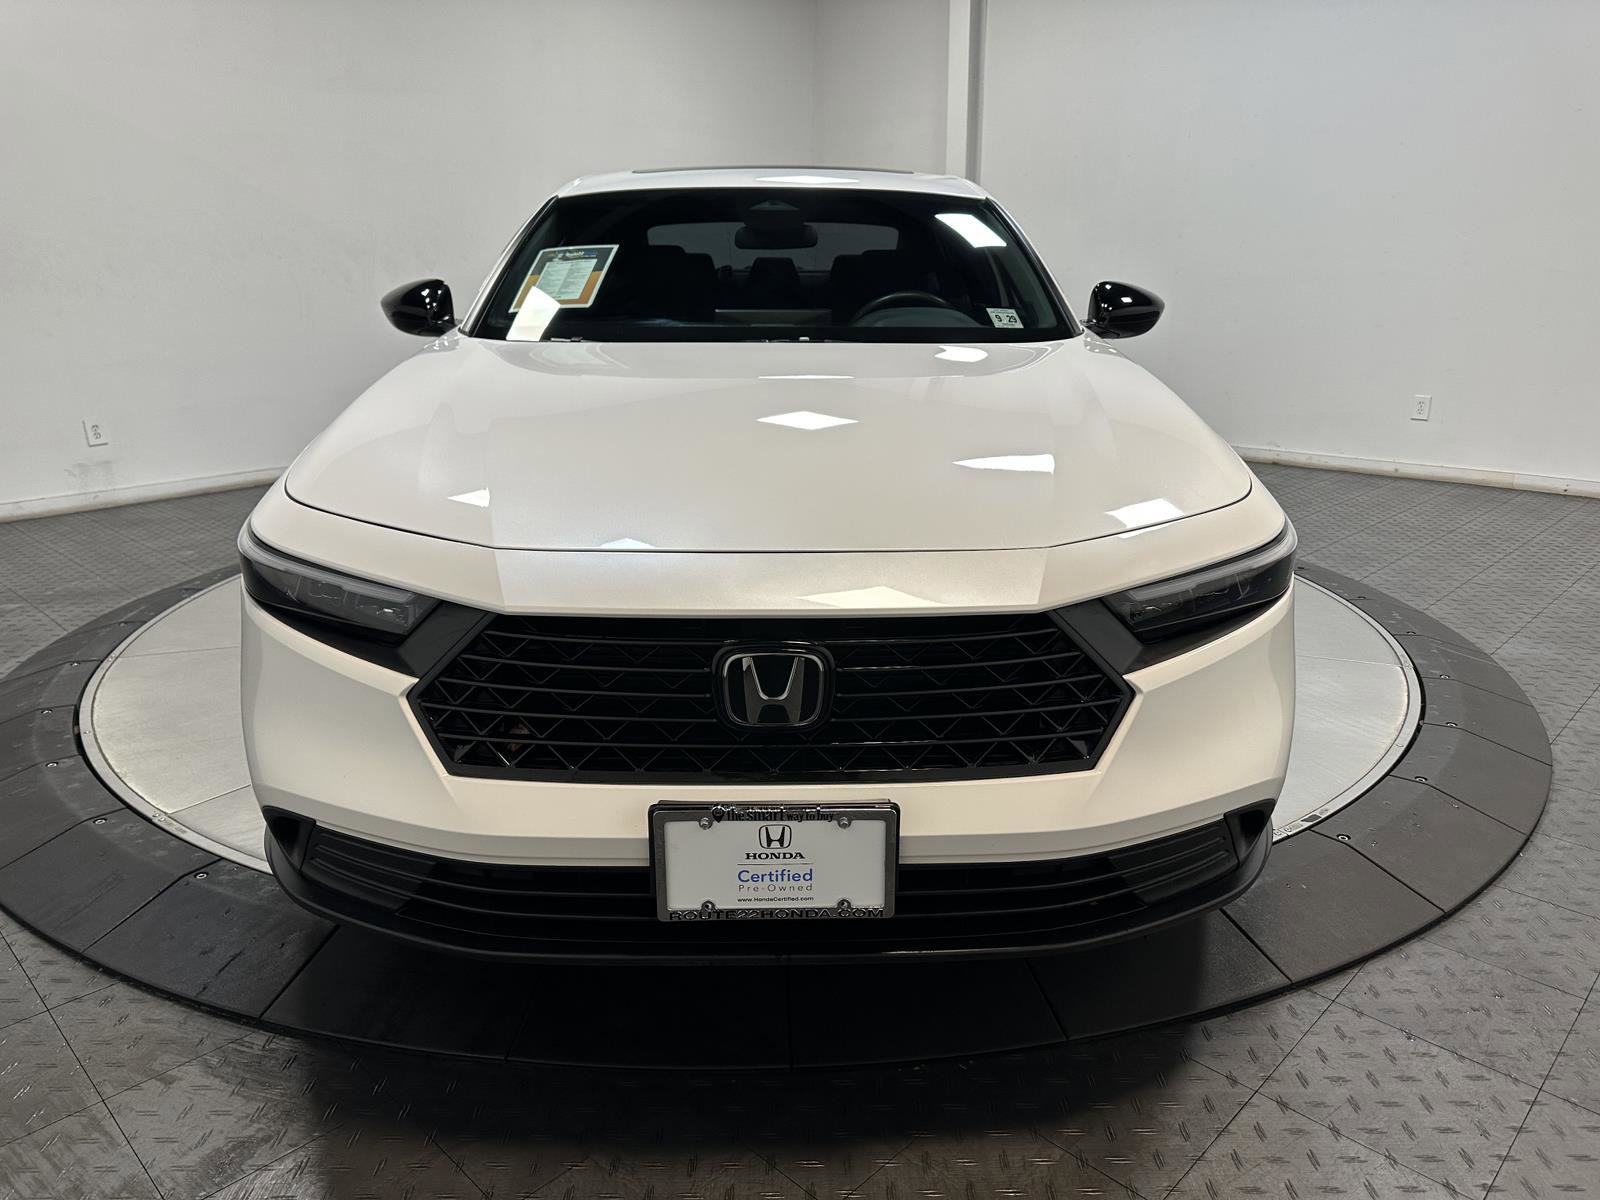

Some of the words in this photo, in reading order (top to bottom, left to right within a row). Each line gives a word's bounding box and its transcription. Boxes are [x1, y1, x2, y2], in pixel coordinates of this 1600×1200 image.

[1006, 315, 1017, 323] 29
[727, 807, 745, 821] the
[746, 808, 784, 821] smart
[786, 811, 804, 822] way
[805, 809, 815, 821] to
[816, 808, 834, 822] buy
[745, 852, 805, 860] HONDA
[737, 868, 813, 883] Certified
[738, 883, 813, 892] Pre-Owned
[669, 908, 884, 920] ROUTE22HONDA.COM
